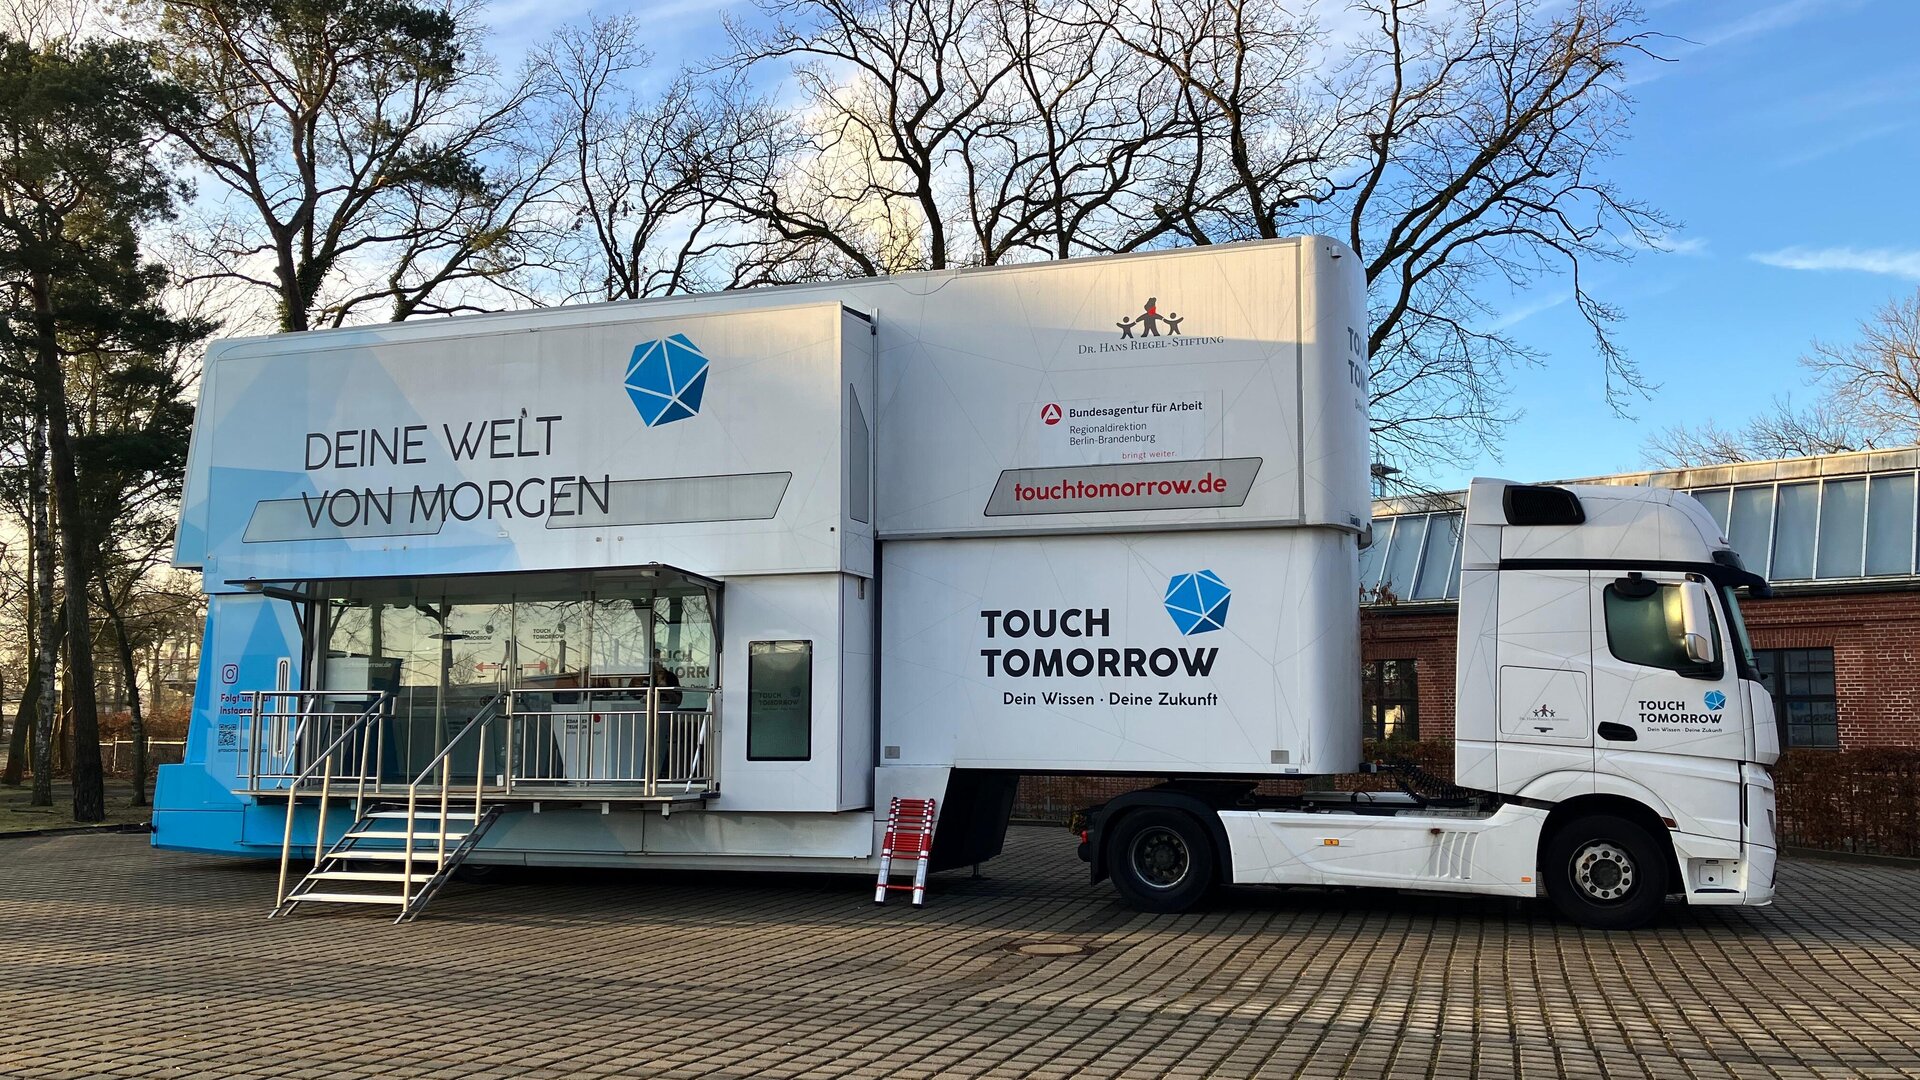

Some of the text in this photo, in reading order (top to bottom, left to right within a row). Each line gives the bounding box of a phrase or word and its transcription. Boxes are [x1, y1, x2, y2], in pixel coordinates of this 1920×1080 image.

[1069, 401, 1203, 418] Bundesagentur für Arbeit
[1069, 422, 1147, 435] Regionaldirektion
[304, 415, 563, 471] DEINE WELT
[1069, 433, 1156, 446] Berlin-Brandenburg
[1122, 451, 1146, 460] bringt
[1014, 472, 1227, 501] touchtomorrow.de
[301, 474, 610, 529] VON MORGEN
[980, 608, 1110, 638] TOUCH
[980, 647, 1219, 677] TOMORROW
[221, 693, 240, 704] Folgt
[1003, 692, 1218, 706] Dein Wissen Deine Zukunft
[220, 706, 258, 715] Instagra
[1638, 701, 1685, 710] TOUCH
[1639, 713, 1722, 723] TOMORROW
